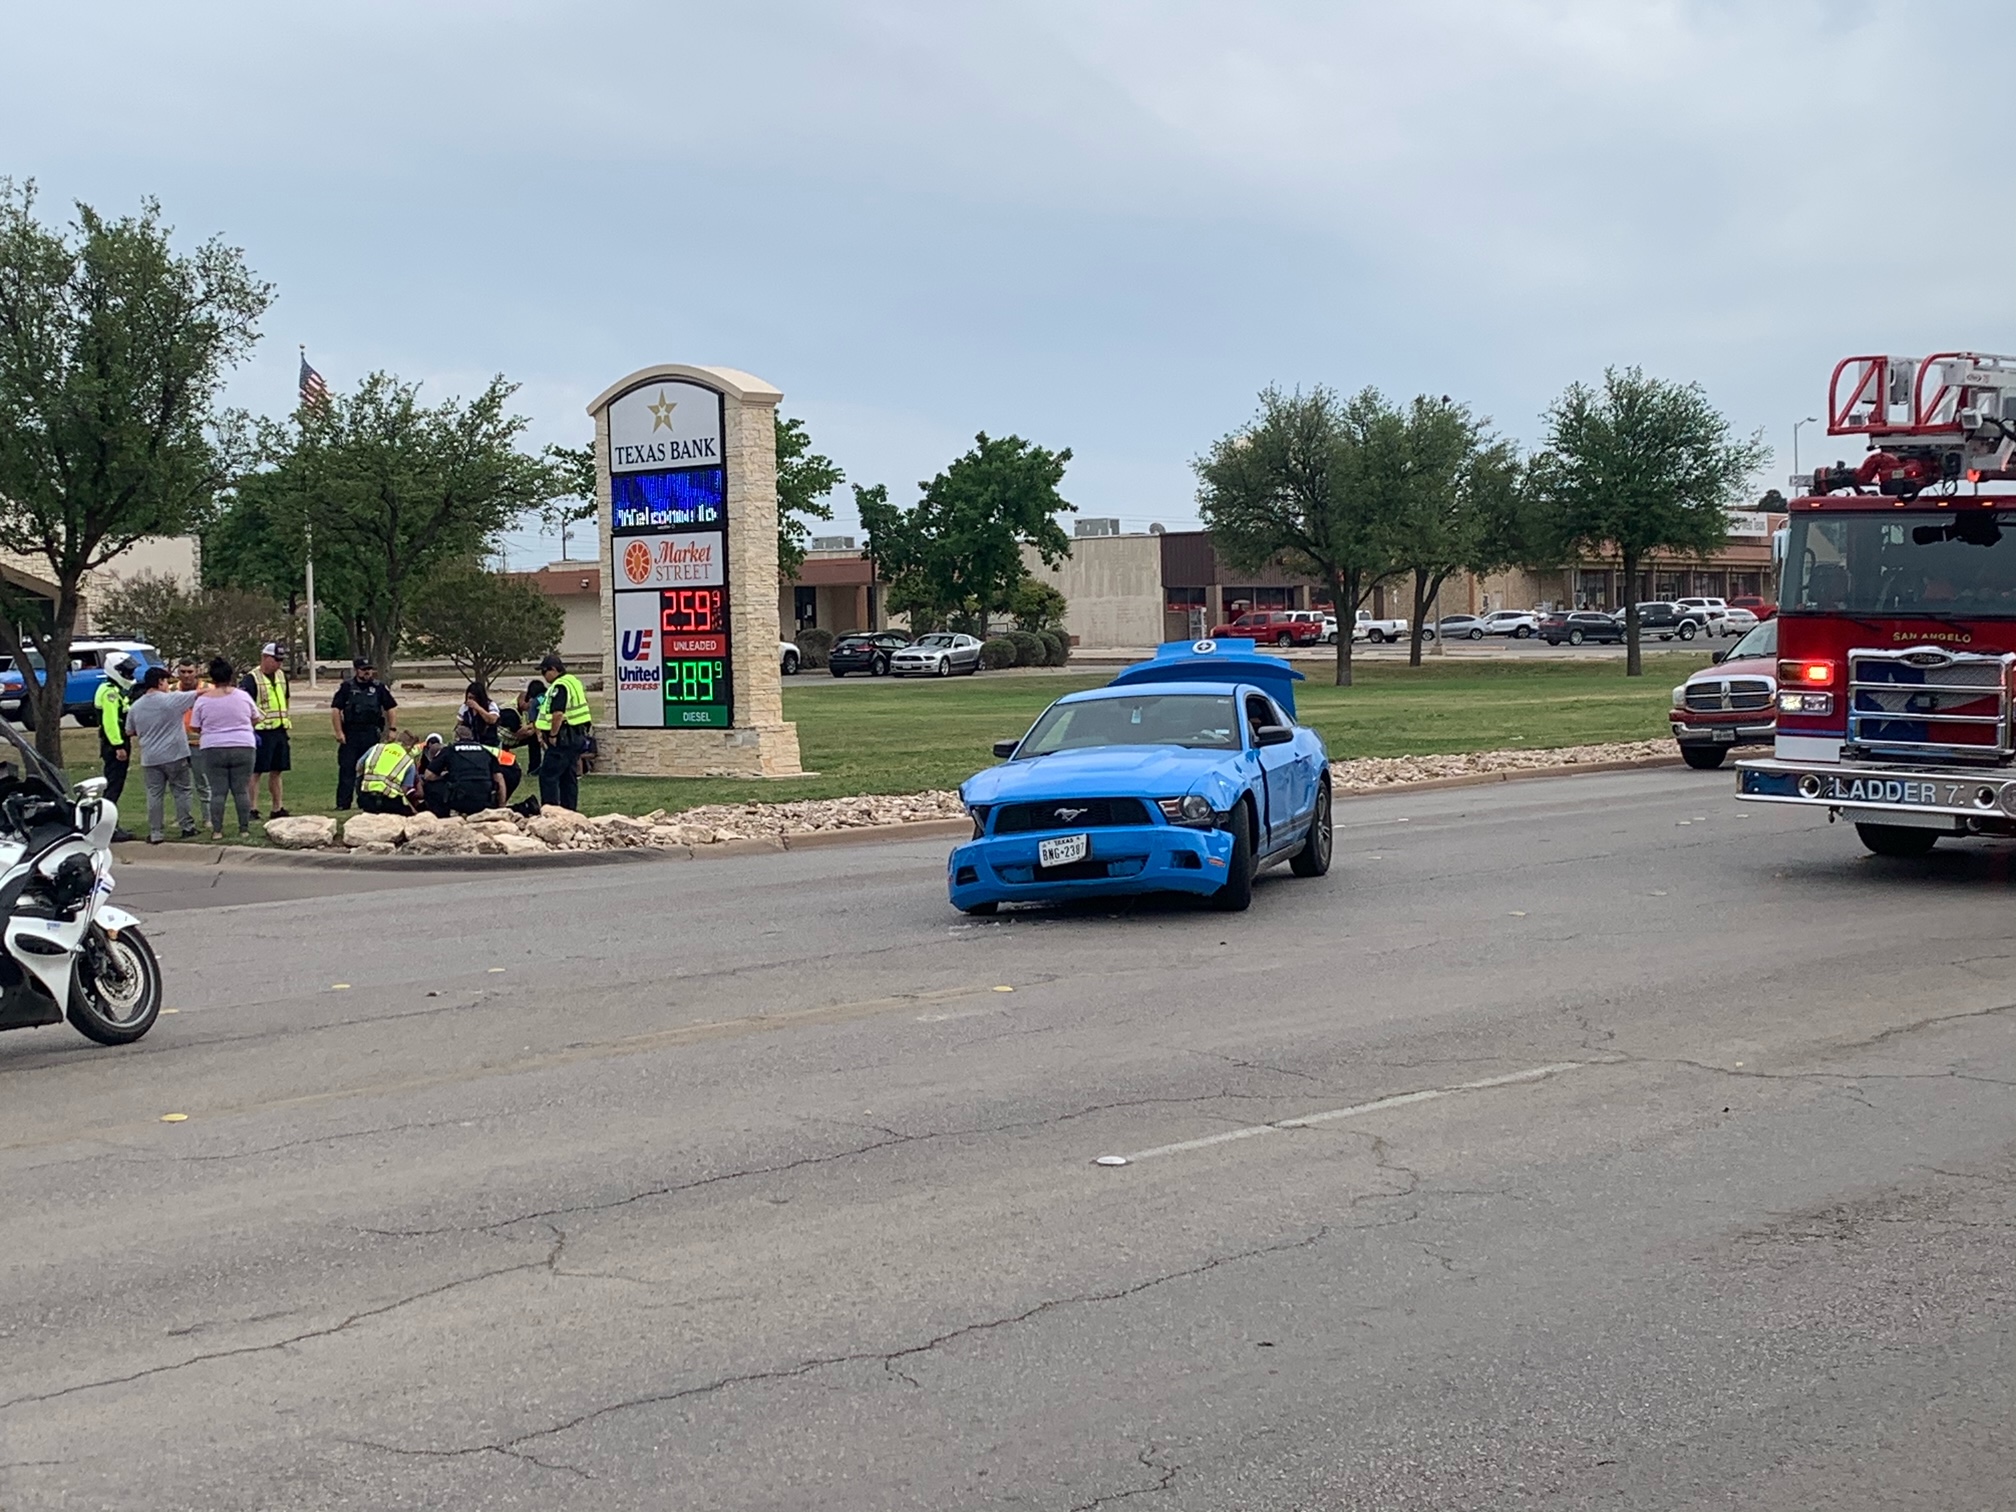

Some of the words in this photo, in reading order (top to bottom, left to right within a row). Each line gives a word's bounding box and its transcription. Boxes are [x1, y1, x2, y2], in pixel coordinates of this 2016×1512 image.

[615, 443, 666, 465] TEXAS
[670, 438, 717, 460] BANK
[654, 541, 712, 564] Market
[655, 563, 713, 581] STREET
[1892, 632, 1917, 641] SAN
[1921, 633, 1972, 643] ANGELO
[673, 640, 717, 652] UNLEADED
[618, 666, 660, 682] United
[620, 683, 659, 691] EXPRESS
[682, 711, 711, 722] DIESEL
[455, 744, 482, 752] POLICE
[1834, 778, 1936, 803] LADDER
[1945, 784, 1959, 804] 7
[1054, 838, 1074, 846] TEXAS
